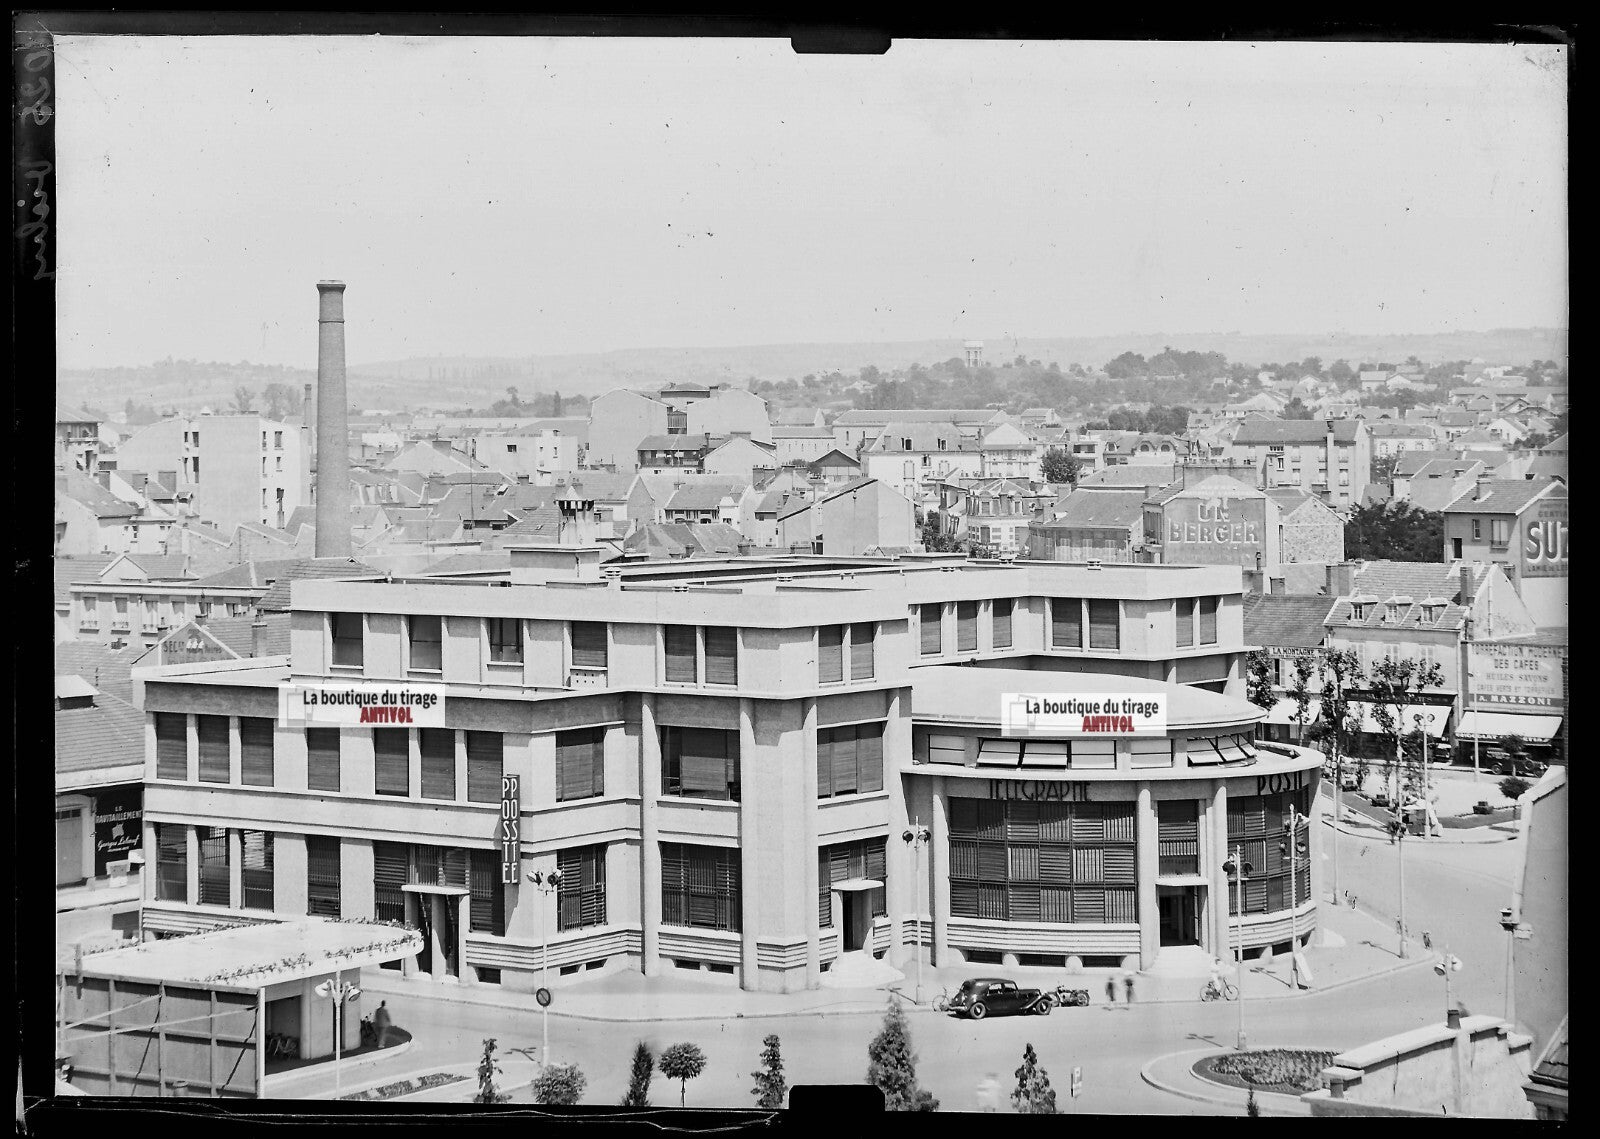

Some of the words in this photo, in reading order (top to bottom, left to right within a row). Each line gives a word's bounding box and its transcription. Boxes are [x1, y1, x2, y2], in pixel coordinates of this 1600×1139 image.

[1168, 519, 1260, 544] BERGER
[1272, 647, 1281, 655] LA
[1283, 647, 1314, 656] MONTAGNE
[1494, 659, 1509, 669] DES
[1486, 672, 1514, 681] HUILES
[1518, 673, 1549, 682] SAVONS
[1490, 695, 1552, 706] MAZZONI
[502, 778, 511, 883] POSTE
